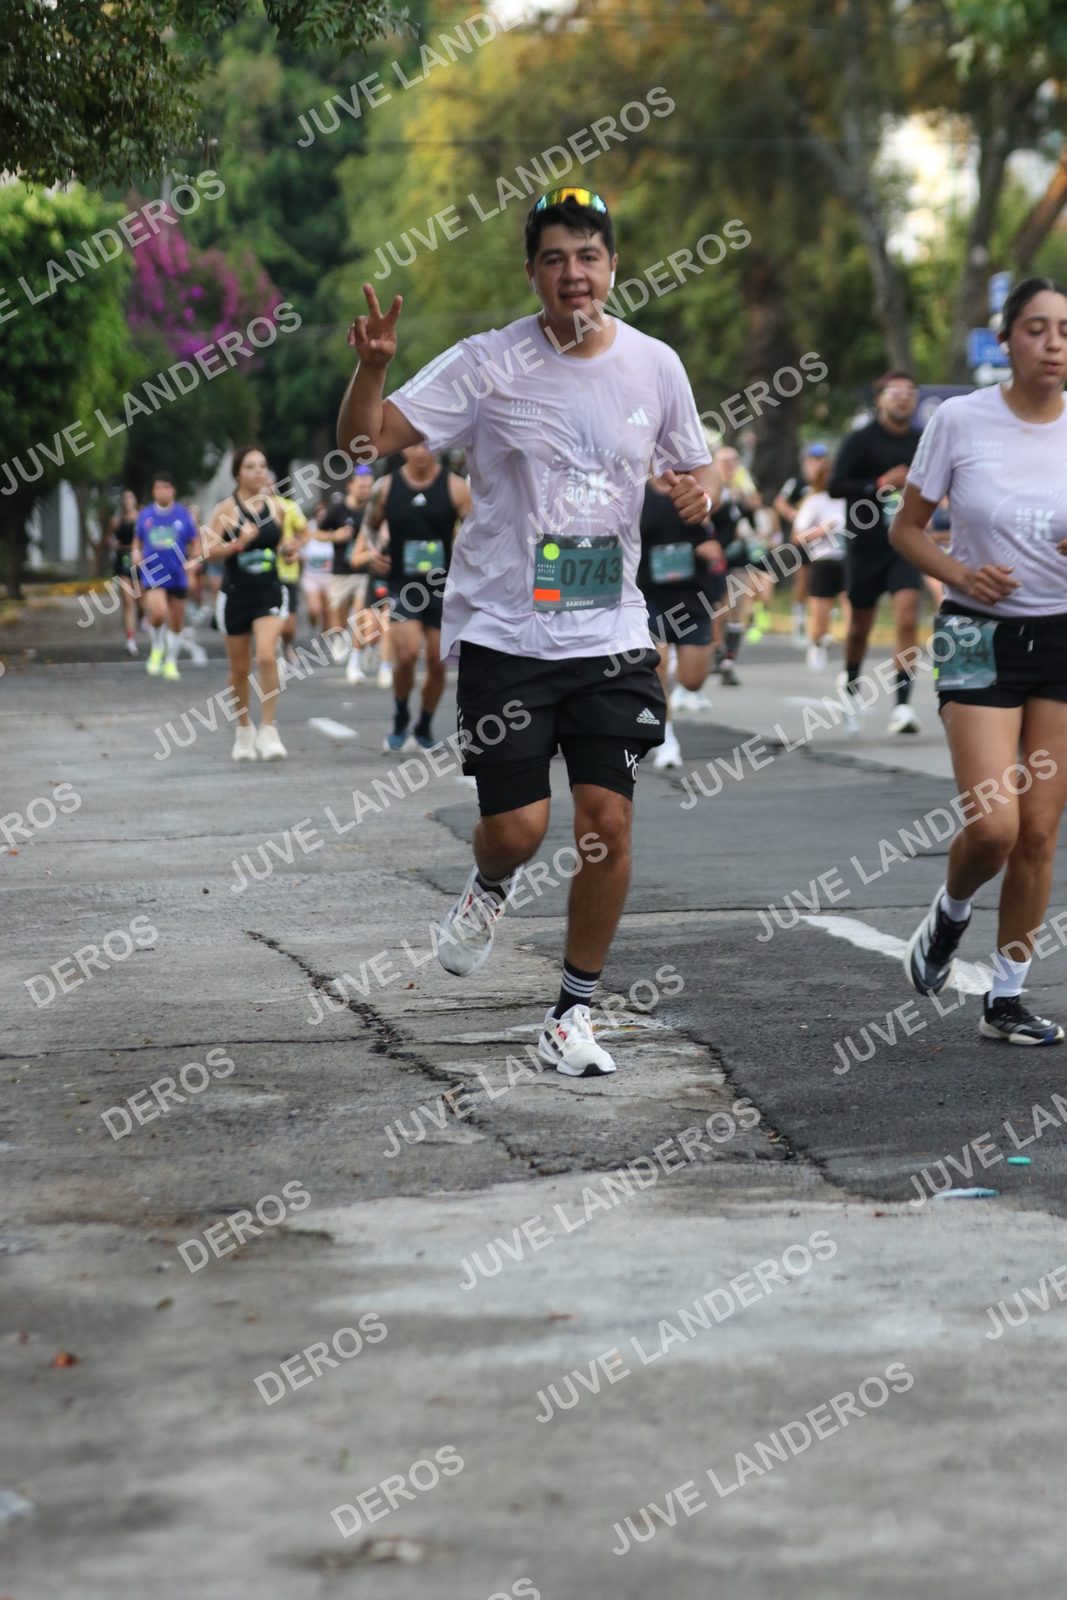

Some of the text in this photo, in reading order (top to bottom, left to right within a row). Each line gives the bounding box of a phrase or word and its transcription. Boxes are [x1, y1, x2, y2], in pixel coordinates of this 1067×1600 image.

[1034, 508, 1056, 540] K
[560, 556, 621, 587] 0743
[565, 600, 594, 608] SAMSUNG
[636, 716, 661, 725] adidas
